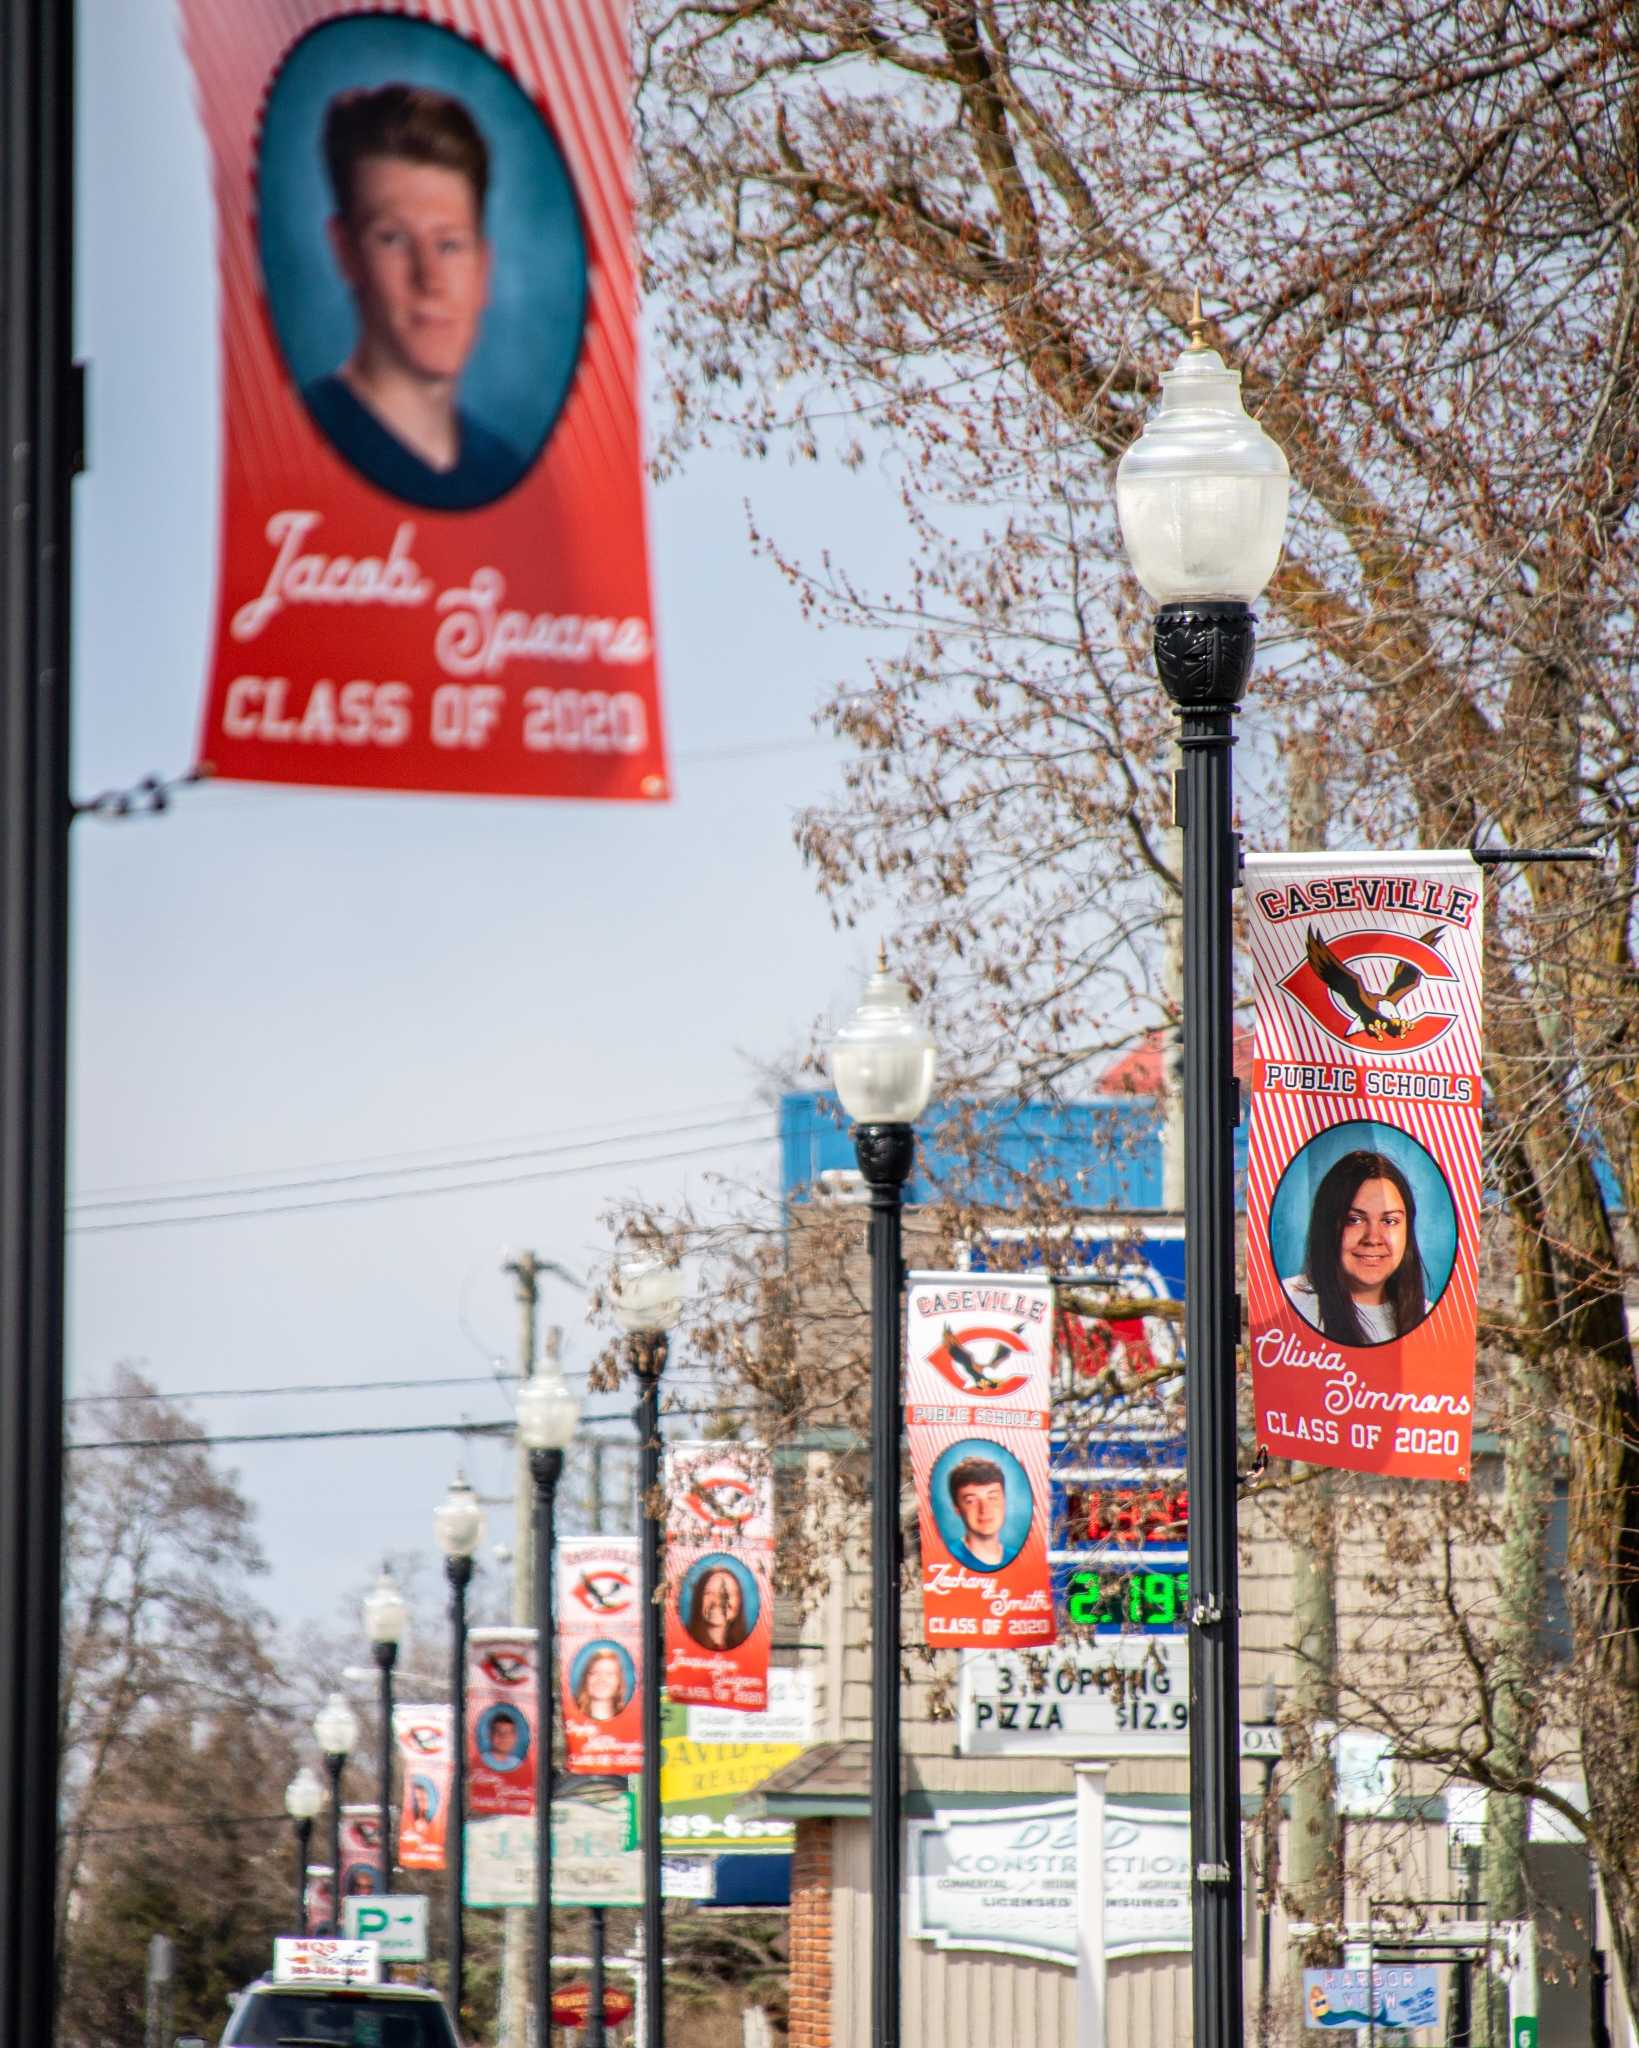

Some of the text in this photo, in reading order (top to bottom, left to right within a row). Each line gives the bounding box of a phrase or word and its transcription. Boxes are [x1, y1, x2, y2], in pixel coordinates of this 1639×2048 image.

[230, 509, 433, 642] Jacob
[222, 675, 648, 753] CLASS OF 2020
[1258, 877, 1477, 928] CASEVILLE
[1265, 1065, 1472, 1101] PUBLIC SCHOOLS
[916, 1289, 1047, 1323] CASEVILLE
[1256, 1328, 1347, 1372] Olivia
[1324, 1371, 1471, 1415] Simmons
[912, 1407, 1041, 1426] PUBLIC SCHOOLS
[1267, 1411, 1460, 1456] CLASS OF 2020
[990, 1588, 1052, 1616] Smith
[928, 1617, 1050, 1636] CLASS OF 2020
[953, 1854, 1191, 1873] CONSTRCTION
[358, 1908, 390, 1939] P
[294, 1941, 338, 1956] MQS
